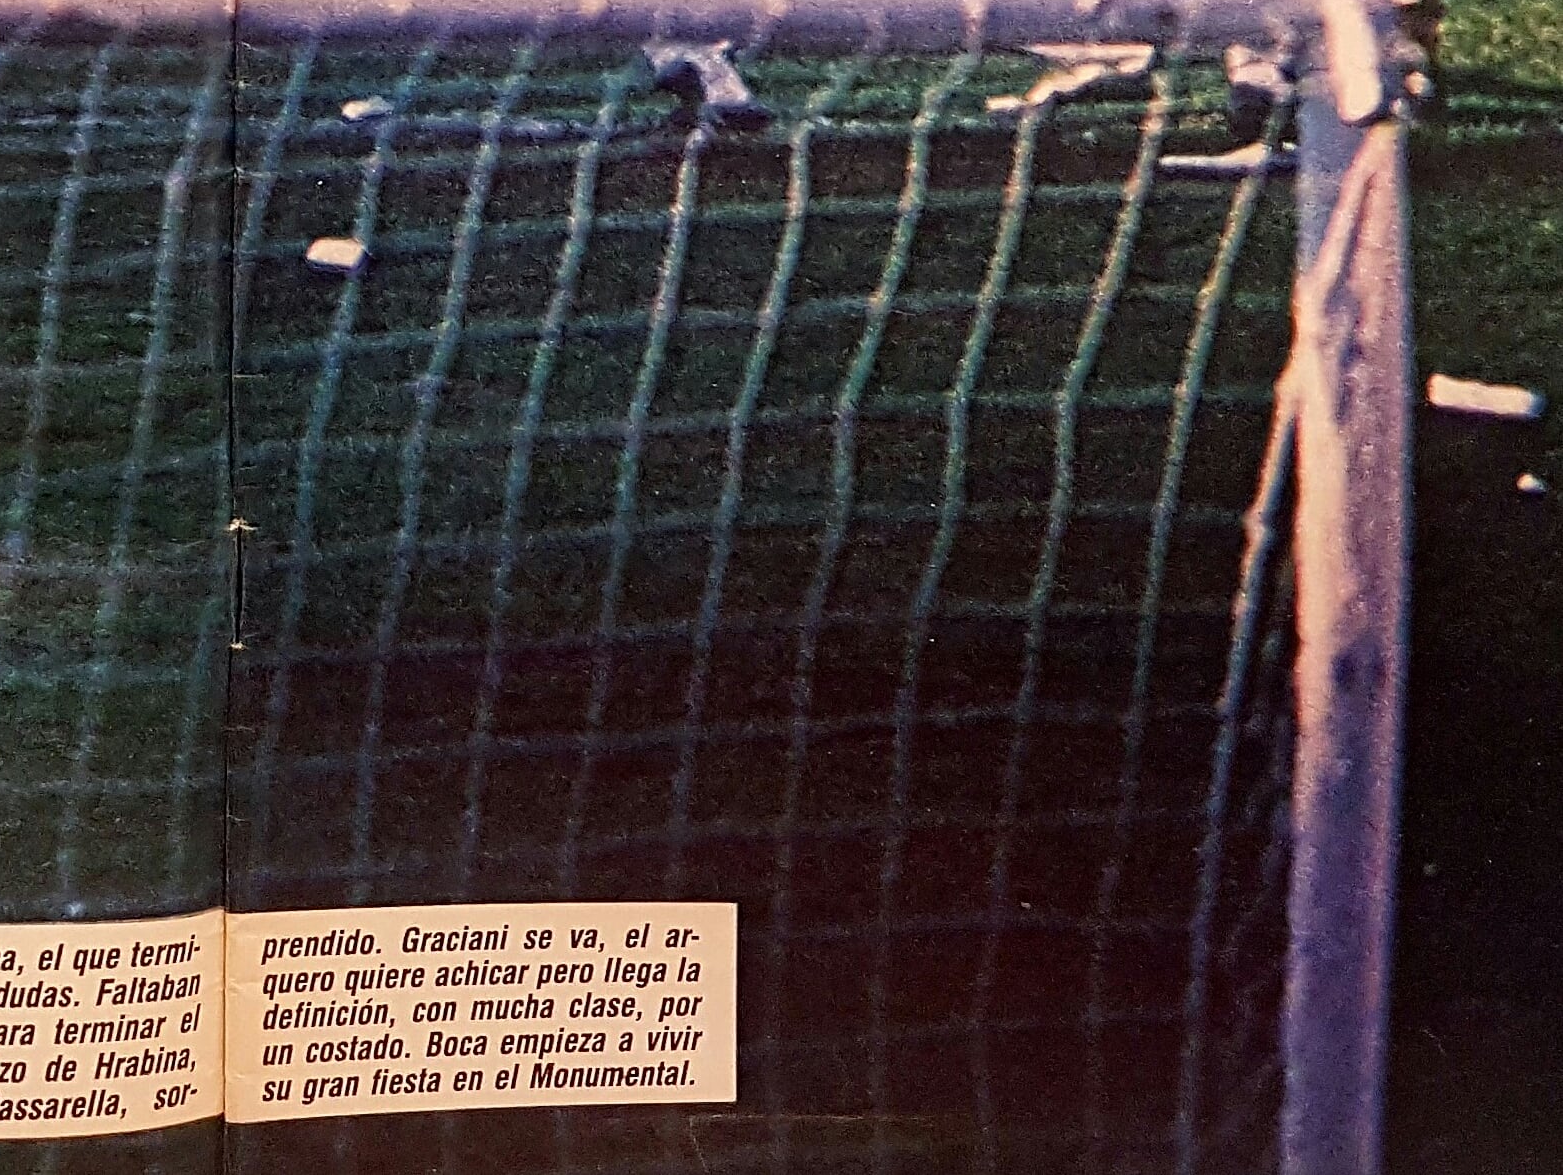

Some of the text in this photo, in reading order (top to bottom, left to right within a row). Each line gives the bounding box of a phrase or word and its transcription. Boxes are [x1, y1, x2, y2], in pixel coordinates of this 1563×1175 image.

[38, 943, 65, 971] el
[72, 947, 121, 977] que
[130, 934, 201, 968] termi-
[260, 922, 700, 966] prendido. Graciani se va, el ar-
[95, 973, 201, 1007] Faltaban
[262, 956, 701, 1001] quero quiere achicar pero llega la
[54, 1014, 168, 1045] terminar
[180, 1002, 202, 1034] el
[262, 991, 703, 1031] definición, con mucha clase, por
[44, 1054, 77, 1083] de
[94, 1046, 196, 1080] Hrabina,
[262, 1025, 704, 1066] un costado. Boca empieza a vivir
[153, 1083, 198, 1111] sor-
[262, 1059, 695, 1106] su gran fiesta en el Monumental.
